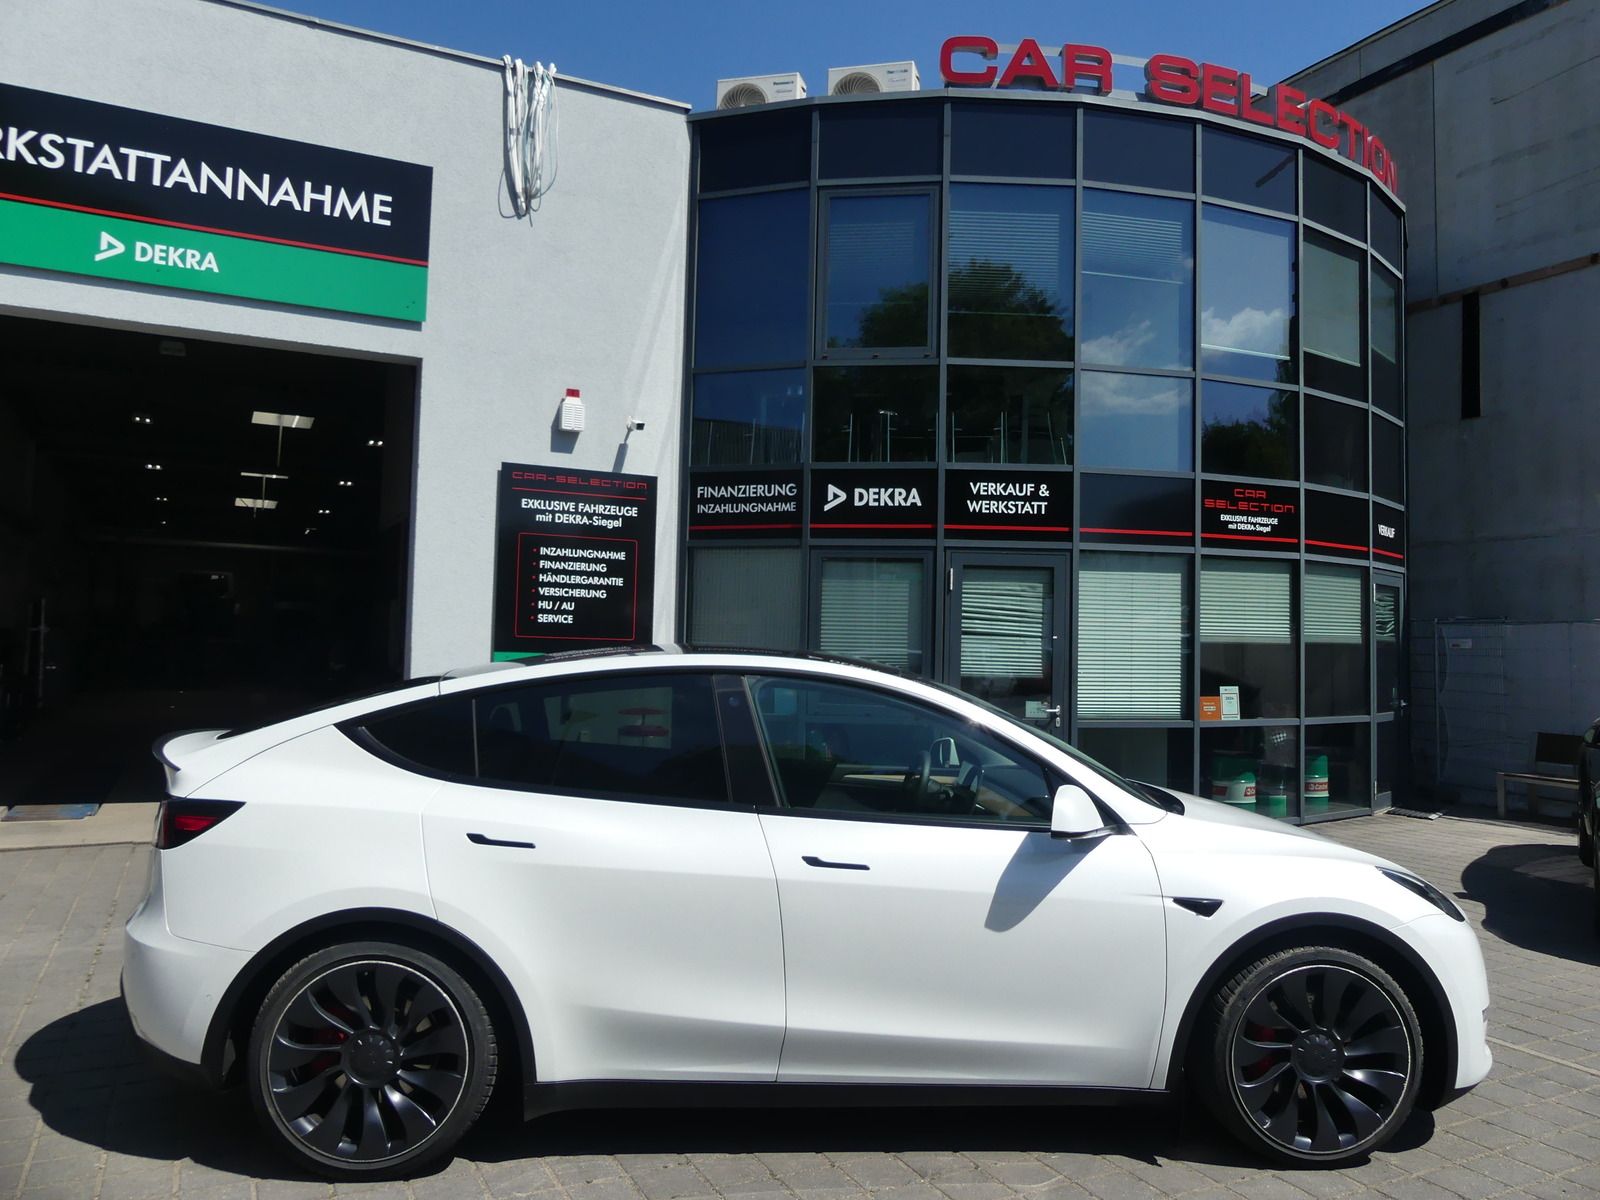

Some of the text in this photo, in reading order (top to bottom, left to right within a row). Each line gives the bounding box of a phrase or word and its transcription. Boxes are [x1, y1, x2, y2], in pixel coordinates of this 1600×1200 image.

[940, 35, 1398, 198] CAR SELECTION
[0, 126, 393, 227] KSTATTANNAHME
[134, 241, 219, 273] DEKRA
[697, 483, 798, 498] FINANZIERUNG
[854, 487, 922, 507] DEKRA
[969, 482, 1050, 497] VERKAUF &
[1234, 488, 1267, 499] CAR
[521, 498, 638, 517] EXKLUSIVE FAHRZEUGE
[697, 501, 797, 514] INZAHLUNGNAHME
[967, 500, 1048, 515] WERKSTATT
[1204, 498, 1295, 514] SELECTION
[535, 512, 623, 529] mit DEKRA-Siegel
[1220, 513, 1278, 525] EXKLUSIVE FAHRZEUGE
[540, 546, 626, 560] INZAHLUNGNAHME
[539, 560, 607, 572] FINANZIERUNG
[539, 572, 624, 586] HÄNDLERGARANTIE
[538, 587, 607, 598] VERSICHERUNG
[538, 600, 553, 609] HU
[560, 602, 575, 610] AU
[537, 613, 573, 624] SERVICE
